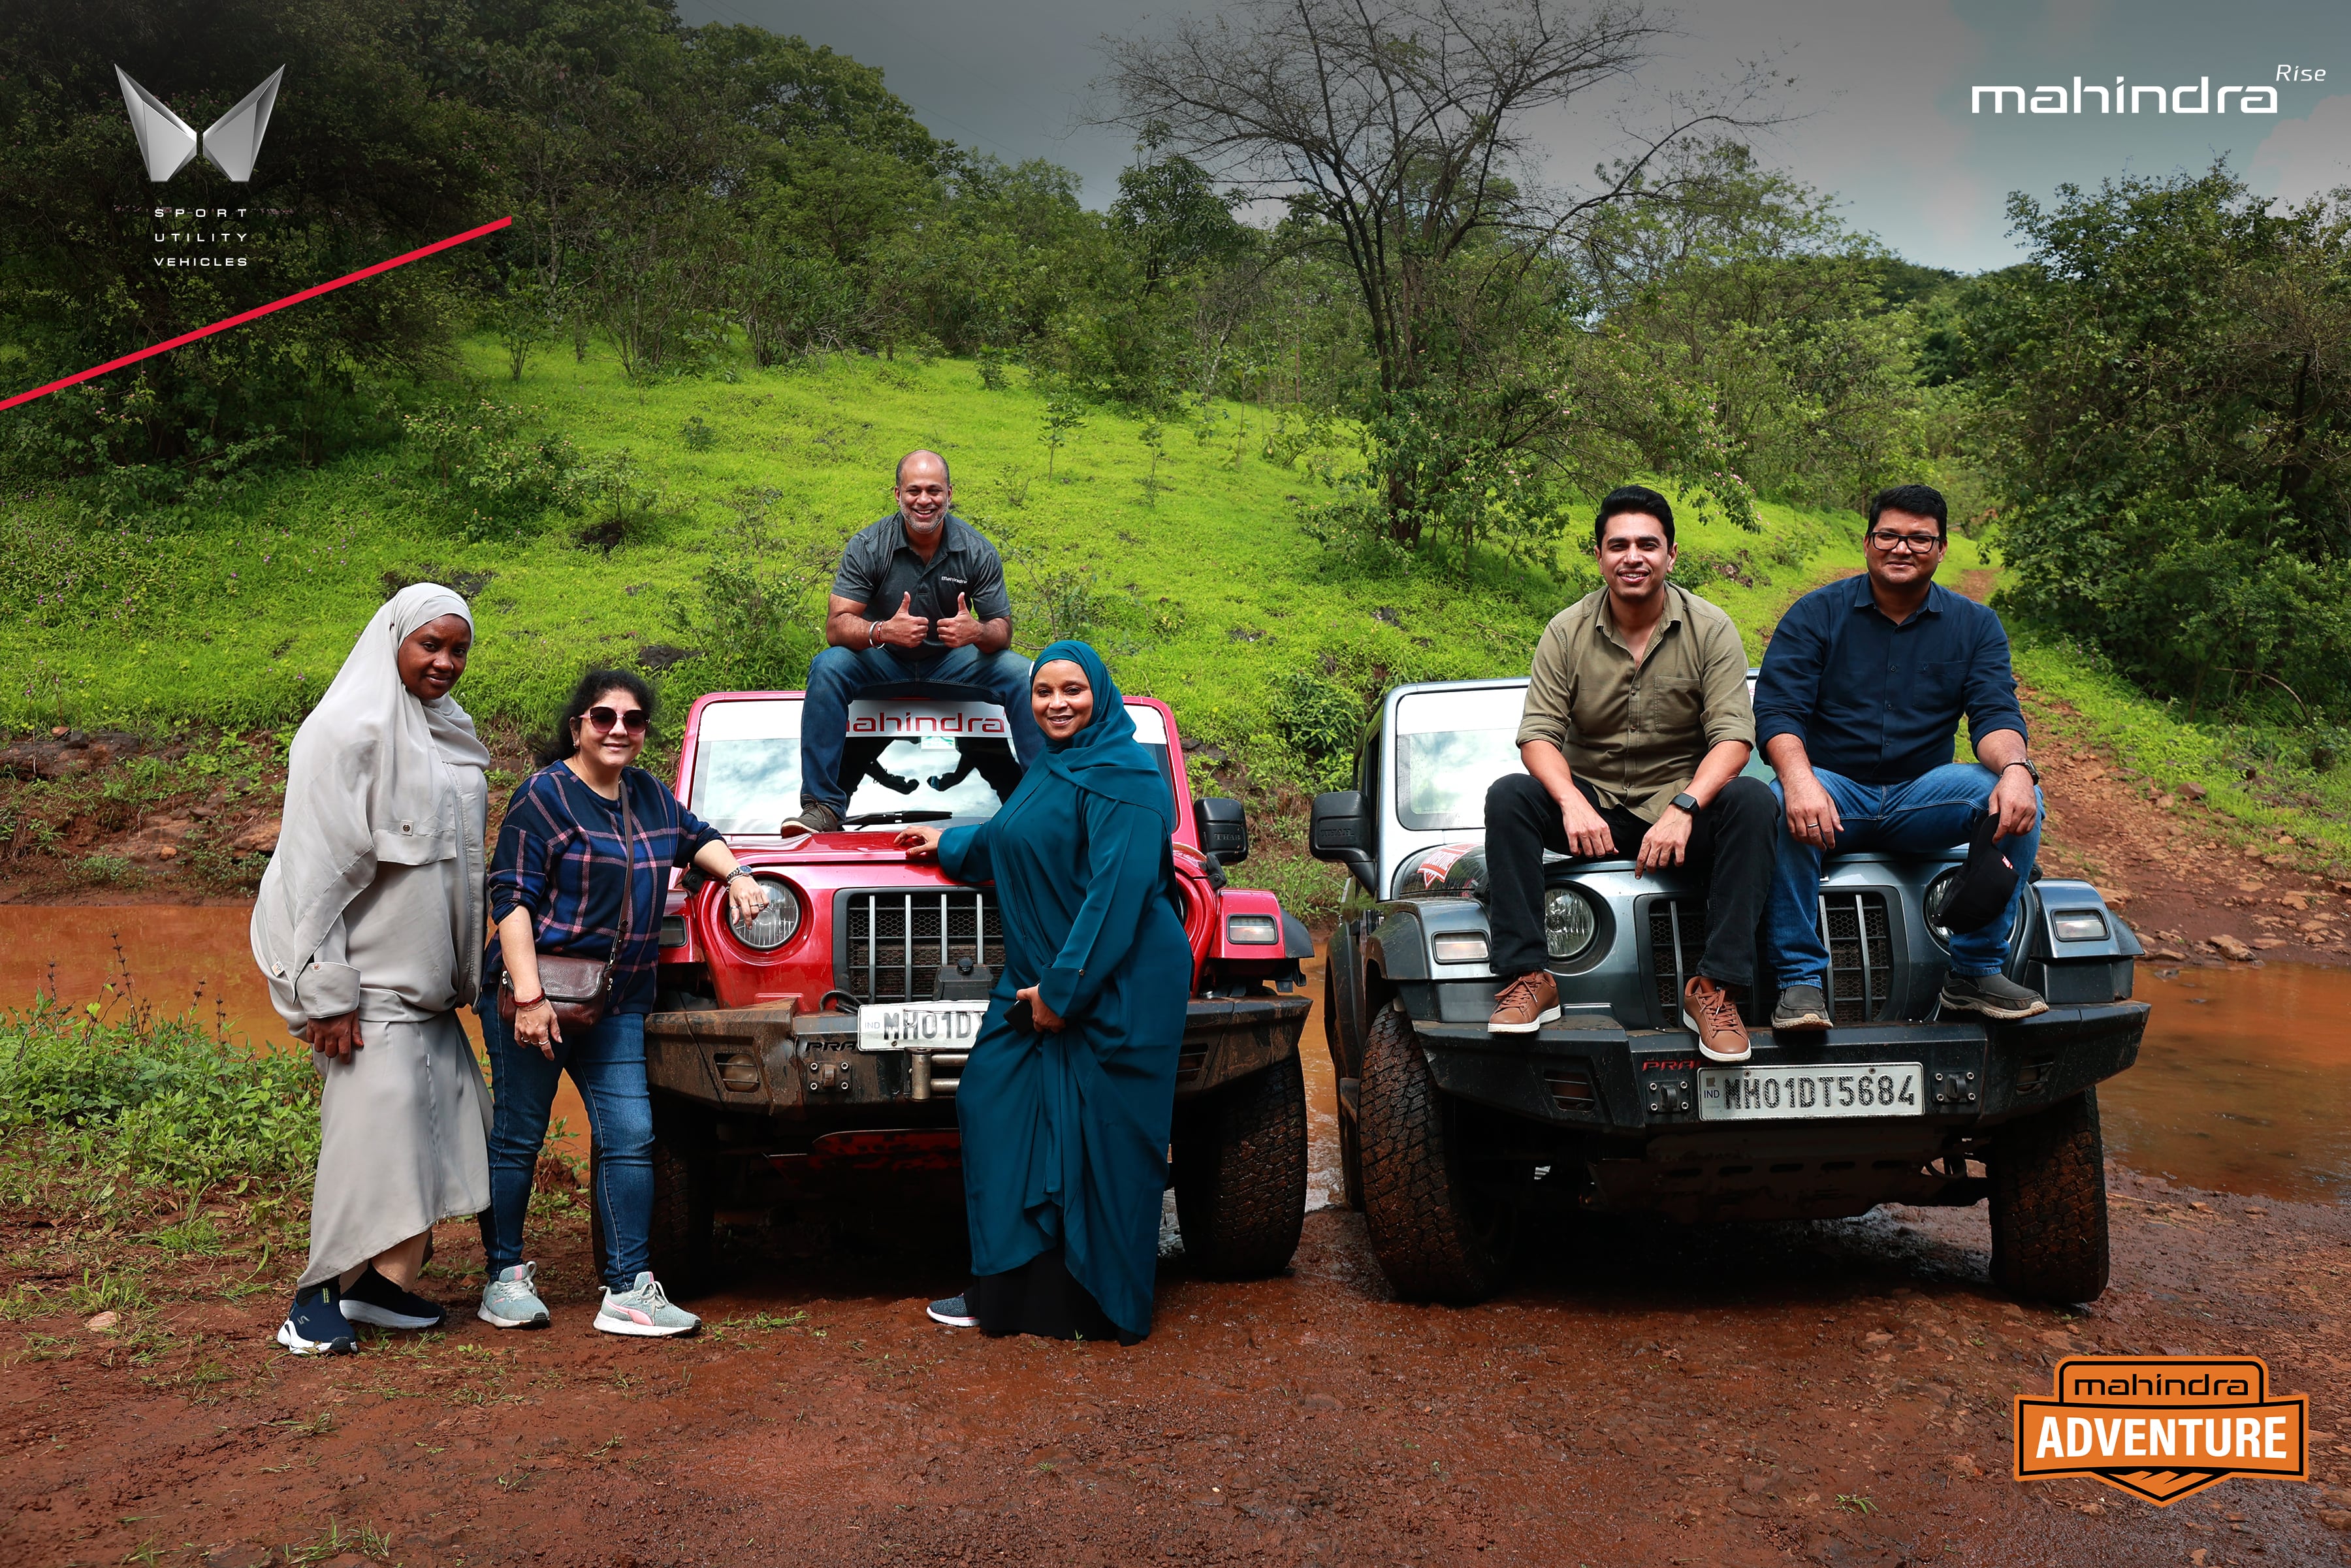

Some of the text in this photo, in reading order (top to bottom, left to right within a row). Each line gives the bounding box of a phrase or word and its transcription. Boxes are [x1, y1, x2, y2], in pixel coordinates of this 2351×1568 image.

[847, 712, 1005, 733] ahindra
[884, 1012, 983, 1040] MH01D
[1704, 1074, 1916, 1109] IND MH01DT5684
